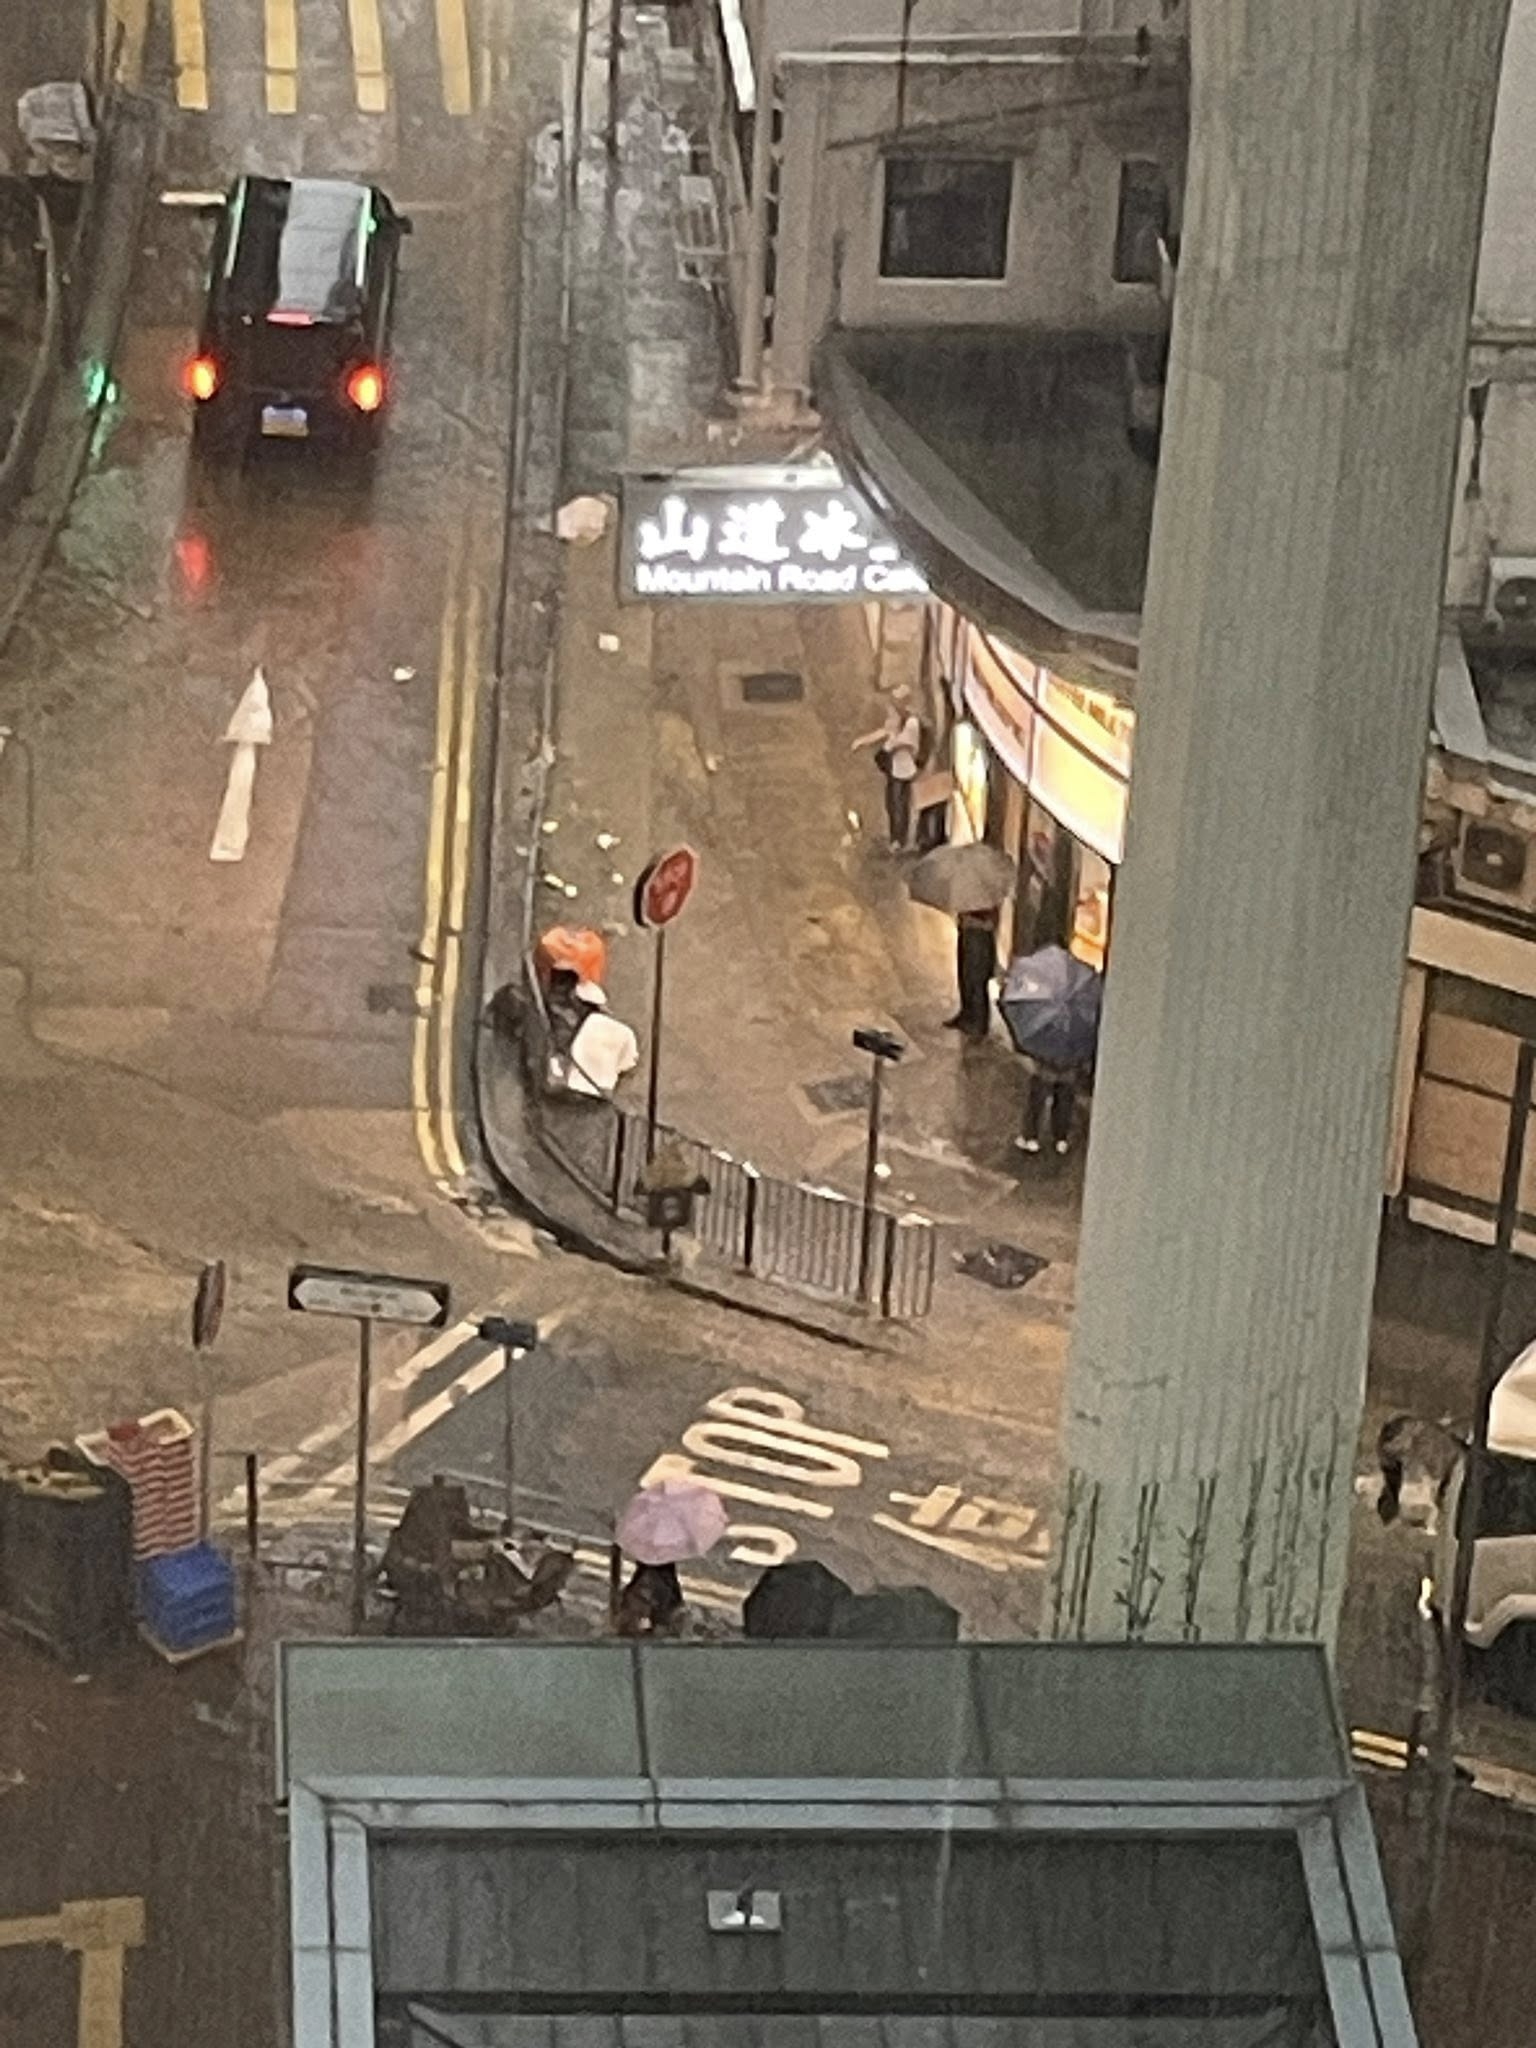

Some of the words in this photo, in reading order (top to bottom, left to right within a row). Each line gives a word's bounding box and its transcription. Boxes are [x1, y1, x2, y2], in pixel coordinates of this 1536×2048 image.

[637, 496, 898, 562] 山道冰
[636, 565, 771, 592] Mountain
[778, 565, 857, 592] Road
